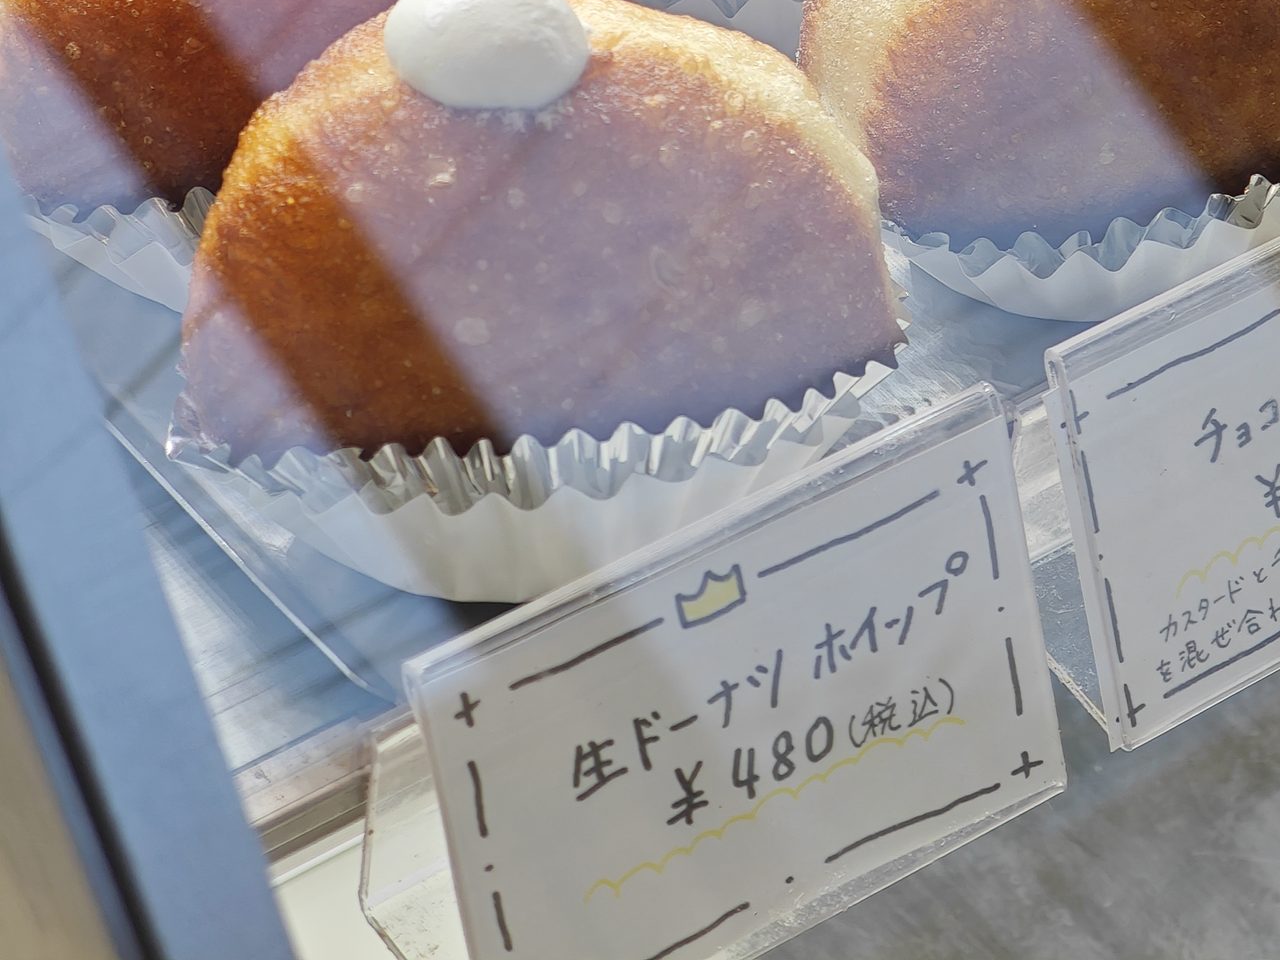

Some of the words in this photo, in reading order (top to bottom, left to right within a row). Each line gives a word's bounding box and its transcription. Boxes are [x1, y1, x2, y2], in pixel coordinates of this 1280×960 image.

[1193, 398, 1280, 463] チョコ
[572, 648, 784, 802] 生ドーナツ
